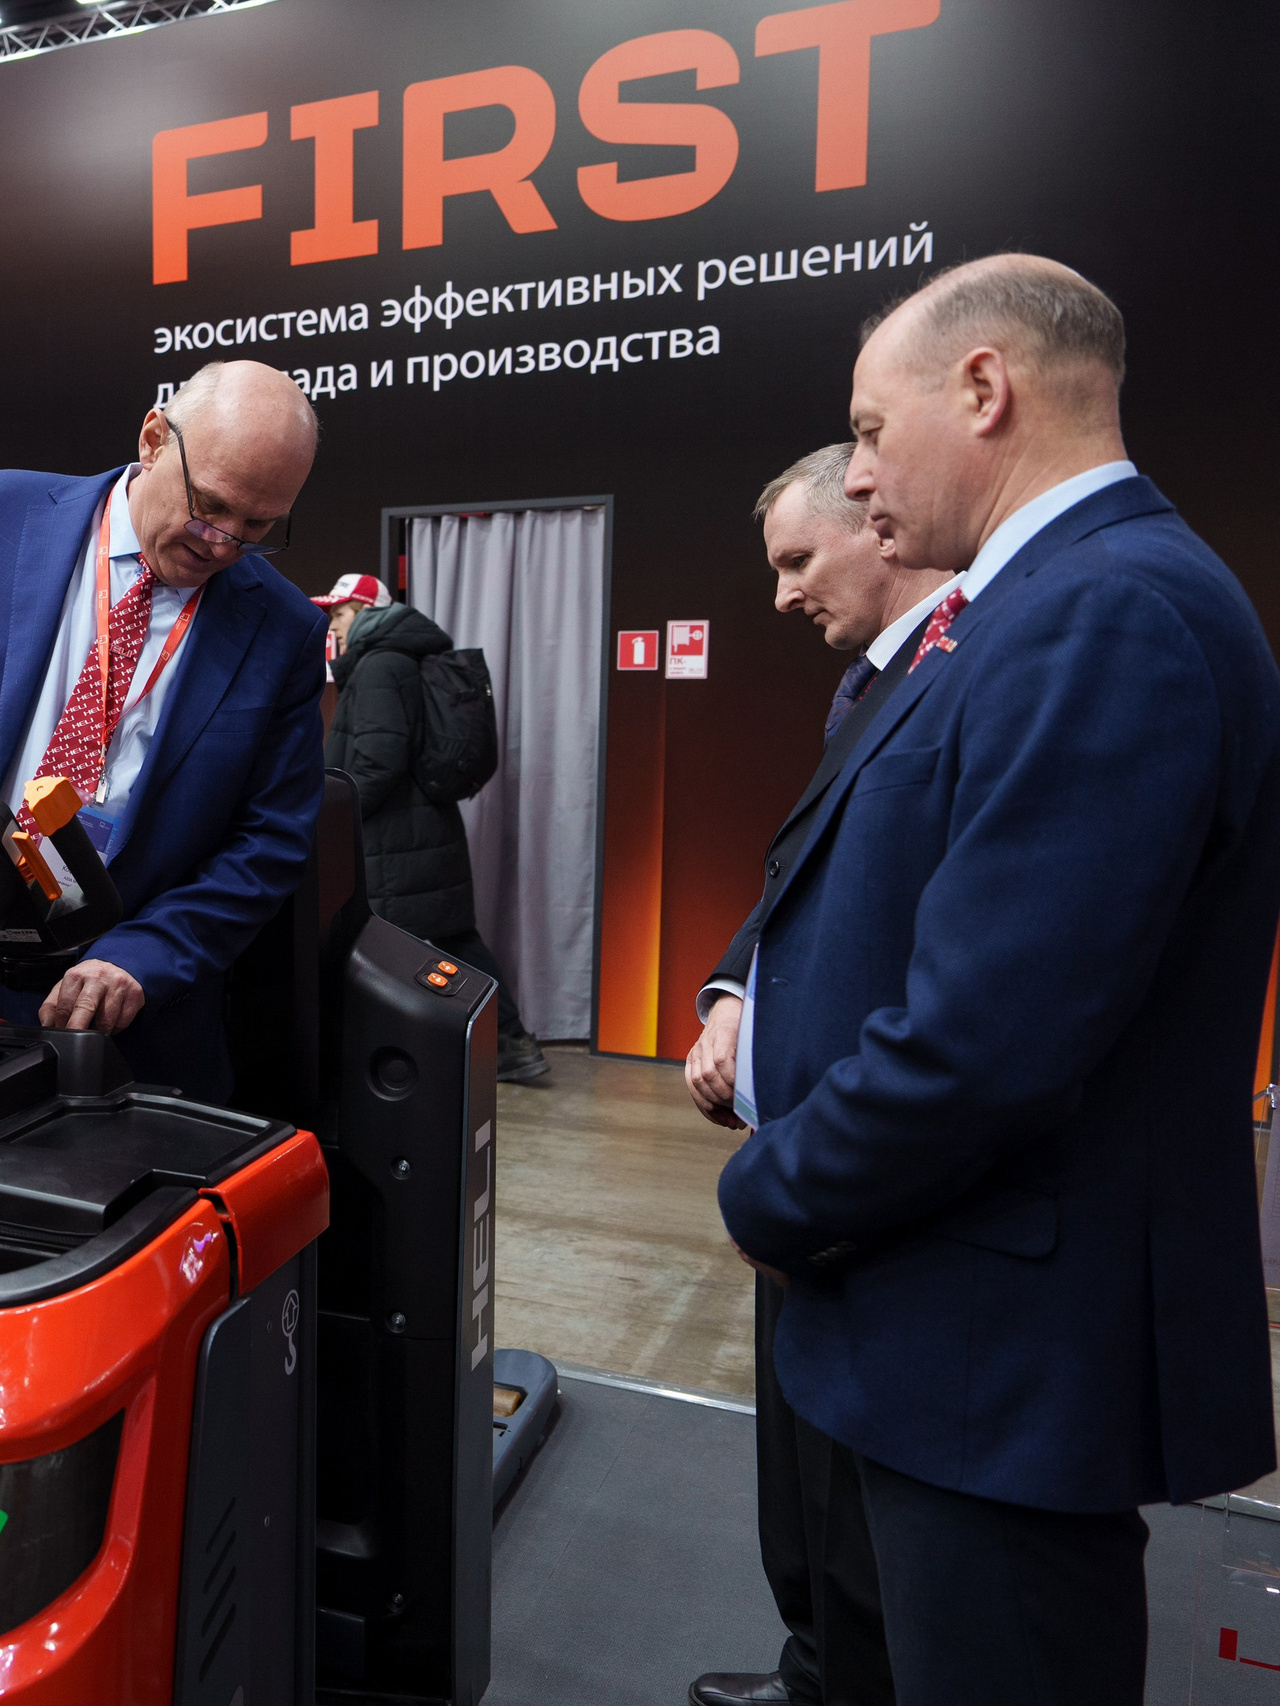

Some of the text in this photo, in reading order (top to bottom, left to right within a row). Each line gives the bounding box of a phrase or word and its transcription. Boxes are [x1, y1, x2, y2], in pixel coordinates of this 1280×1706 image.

[152, 0, 941, 285] FIRST
[153, 221, 934, 354] экосистема эффективных решений
[370, 359, 394, 388] и
[407, 325, 720, 392] производства
[114, 605, 137, 618] HELI
[120, 620, 142, 633] HELI
[76, 690, 99, 702] HELI
[65, 703, 87, 714] HELI
[72, 718, 94, 729] HELI
[59, 730, 82, 742] HELI
[78, 732, 100, 744] HELI
[46, 744, 69, 756] HELI
[65, 746, 88, 757] HELI
[52, 758, 76, 770] HELI
[72, 760, 94, 772] HELI
[78, 774, 100, 787] HELI
[471, 1119, 491, 1371] HELI
